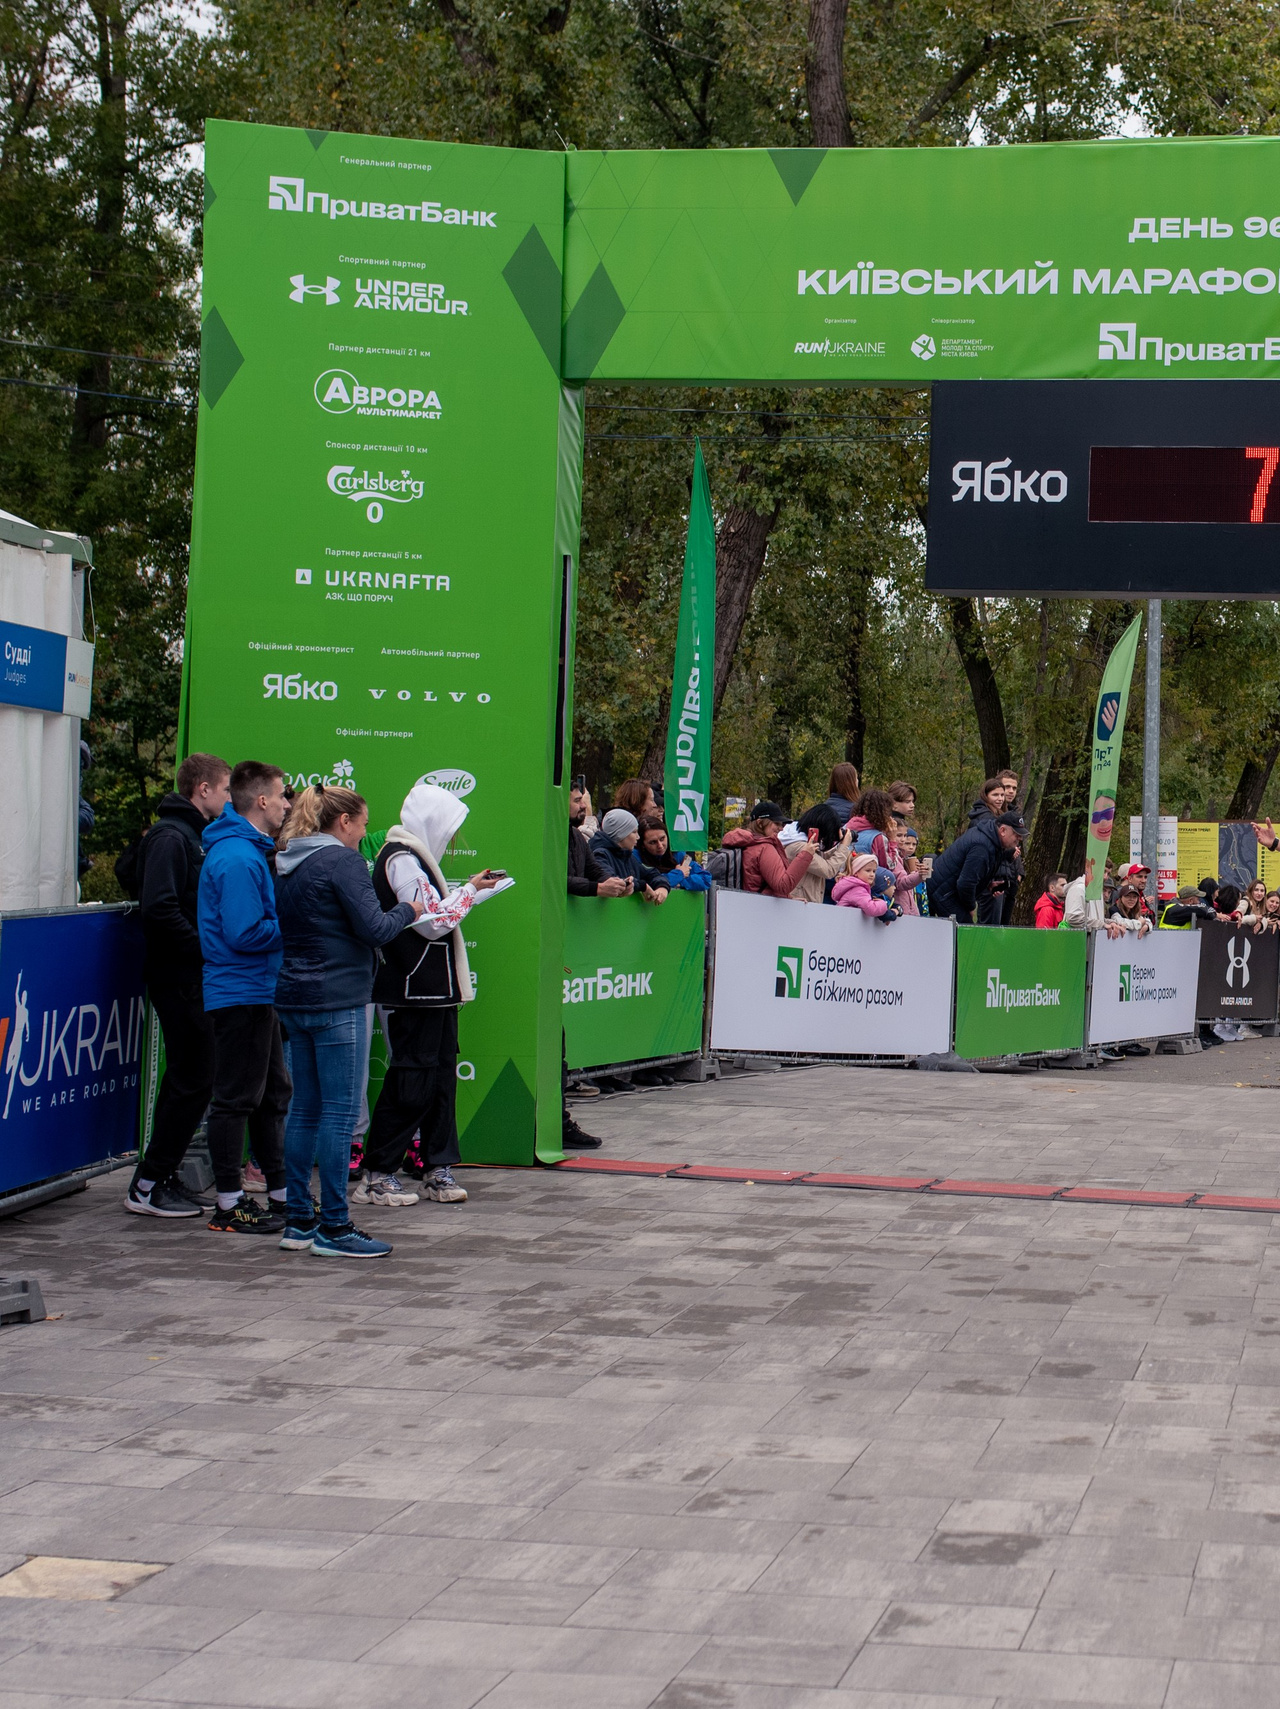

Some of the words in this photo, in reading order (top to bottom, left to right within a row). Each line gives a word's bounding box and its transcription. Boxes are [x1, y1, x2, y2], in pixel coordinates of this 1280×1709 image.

[340, 156, 395, 167] Генеральний
[398, 162, 431, 171] партнер
[307, 192, 496, 227] ПриватБанк
[1129, 218, 1233, 243] ДЕНЬ
[339, 255, 389, 265] Спортивний
[393, 261, 426, 269] партнер
[798, 261, 1058, 295] КИЇВСЬКИЙ
[356, 278, 445, 298] UNDER
[354, 294, 468, 316] ARMOUR
[329, 343, 364, 353] Партнер
[366, 345, 407, 356] дистанції
[357, 407, 442, 420] МУЛЬТИМАРКЕТ
[326, 441, 361, 451] Спонсор
[363, 444, 403, 452] дистанції
[327, 465, 424, 500] Carlsberg
[952, 457, 1068, 503] Ябко
[366, 502, 383, 523] 0
[326, 548, 360, 558] Партнер
[363, 551, 402, 559] дистанції
[326, 570, 449, 591] UKRNAFTA
[326, 593, 345, 601] АЗК,
[365, 594, 393, 602] ПОРУЧ
[4, 640, 31, 666] Судді
[249, 642, 292, 650] Офіційний
[296, 646, 354, 654] хронометрист
[381, 648, 444, 656] Автомобільний
[4, 668, 26, 685] Judges
[263, 673, 337, 700] Ябко
[369, 689, 490, 703] VOLVO
[336, 728, 371, 736] Офіційні
[808, 950, 862, 977] беремо
[1132, 965, 1155, 982] беремо
[806, 980, 810, 1000] і
[814, 980, 863, 1004] біжимо
[866, 989, 903, 1009] разом
[999, 984, 1060, 1012] ПриватБанк
[1135, 986, 1156, 1002] біжимо
[1158, 986, 1176, 1003] разом
[1221, 997, 1234, 1006] UNDER
[1235, 997, 1252, 1006] ARMOUR
[22, 1097, 40, 1114] WE
[50, 1089, 75, 1107] ARE
[84, 1080, 116, 1099] ROAD
